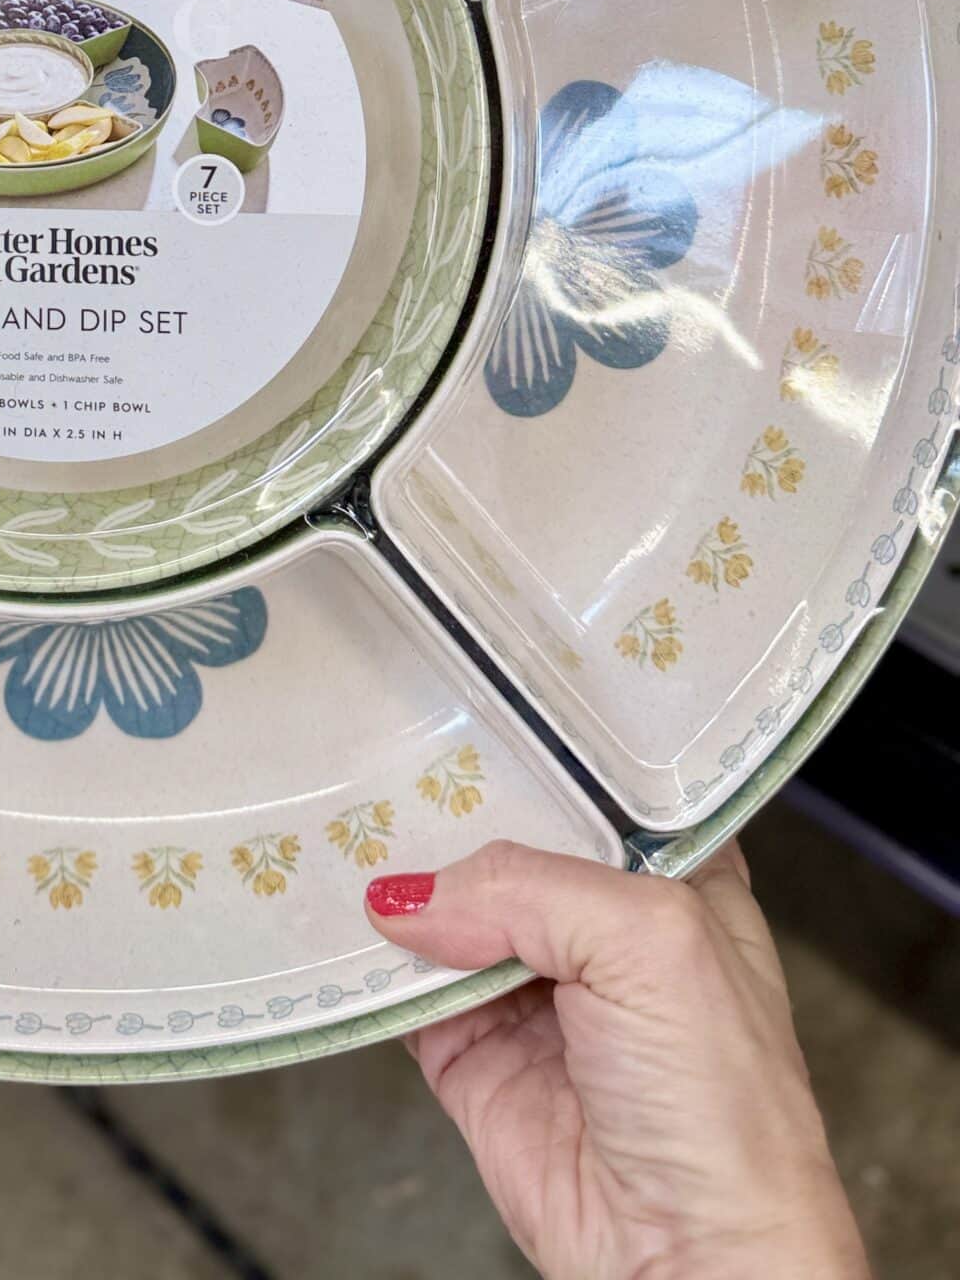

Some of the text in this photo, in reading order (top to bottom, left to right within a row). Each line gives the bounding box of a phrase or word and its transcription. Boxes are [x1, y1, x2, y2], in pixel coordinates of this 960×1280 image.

[200, 165, 218, 189] 7
[189, 191, 228, 202] PIECE
[197, 203, 221, 215] SET
[48, 228, 158, 257] Homes
[1, 307, 66, 331] AND
[81, 308, 126, 333] DIP
[139, 310, 188, 335] SET
[24, 352, 43, 362] Safe
[47, 353, 65, 363] and
[68, 353, 86, 363] BPA
[90, 354, 110, 364] Free
[28, 373, 46, 383] and
[49, 373, 99, 385] Dishwasher
[103, 375, 123, 385] Safe
[0, 398, 45, 410] BOWLS
[74, 400, 106, 412] CHIP
[113, 402, 152, 414] BOWL
[3, 426, 17, 437] IN
[24, 427, 47, 439] DIA
[53, 428, 61, 439] X
[66, 429, 85, 439] 2.5
[92, 430, 106, 440] IN
[113, 431, 122, 441] H
